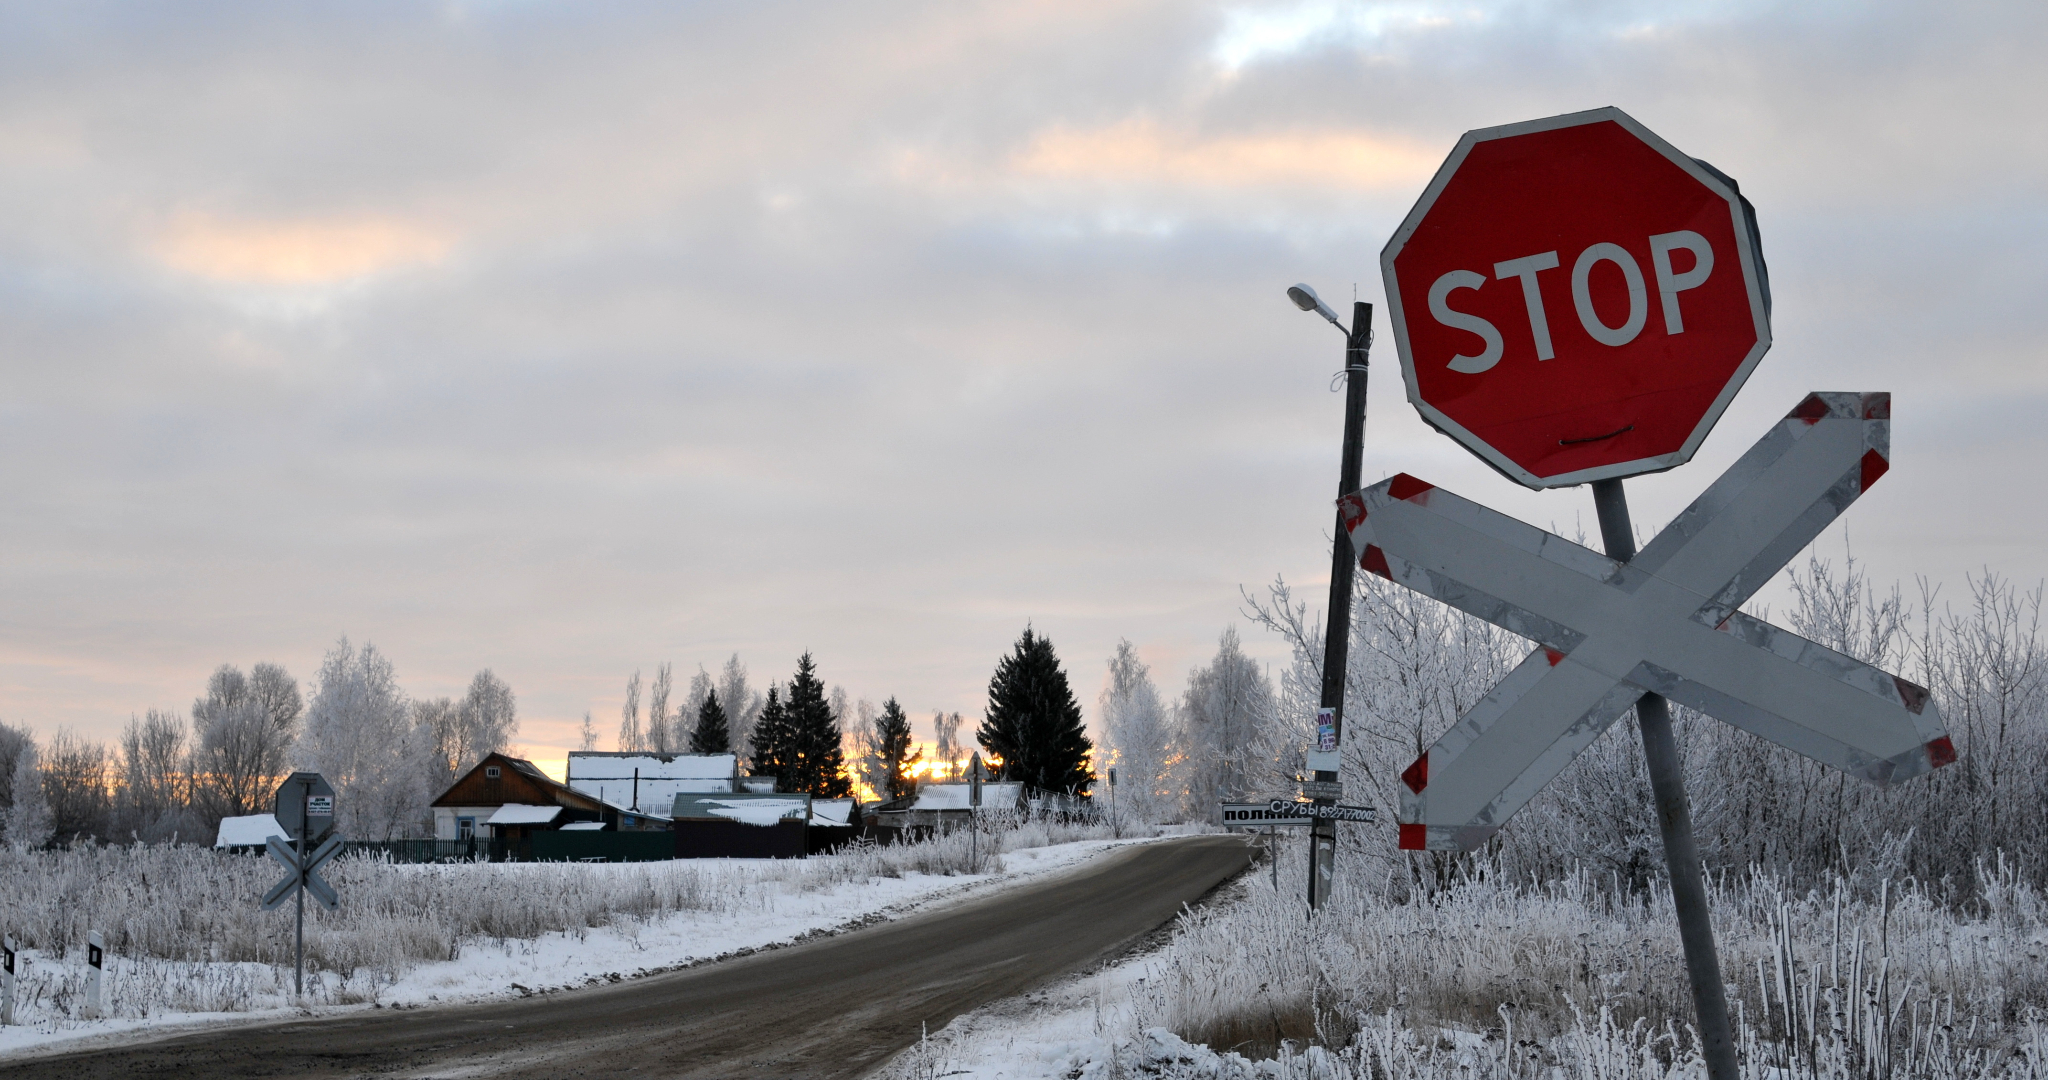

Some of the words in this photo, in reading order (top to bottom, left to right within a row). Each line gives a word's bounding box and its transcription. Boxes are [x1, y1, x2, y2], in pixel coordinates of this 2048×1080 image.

[1428, 230, 1714, 374] STOP
[1225, 810, 1310, 820] ПОЛЯ
[1270, 801, 1318, 815] СРУБЫ
